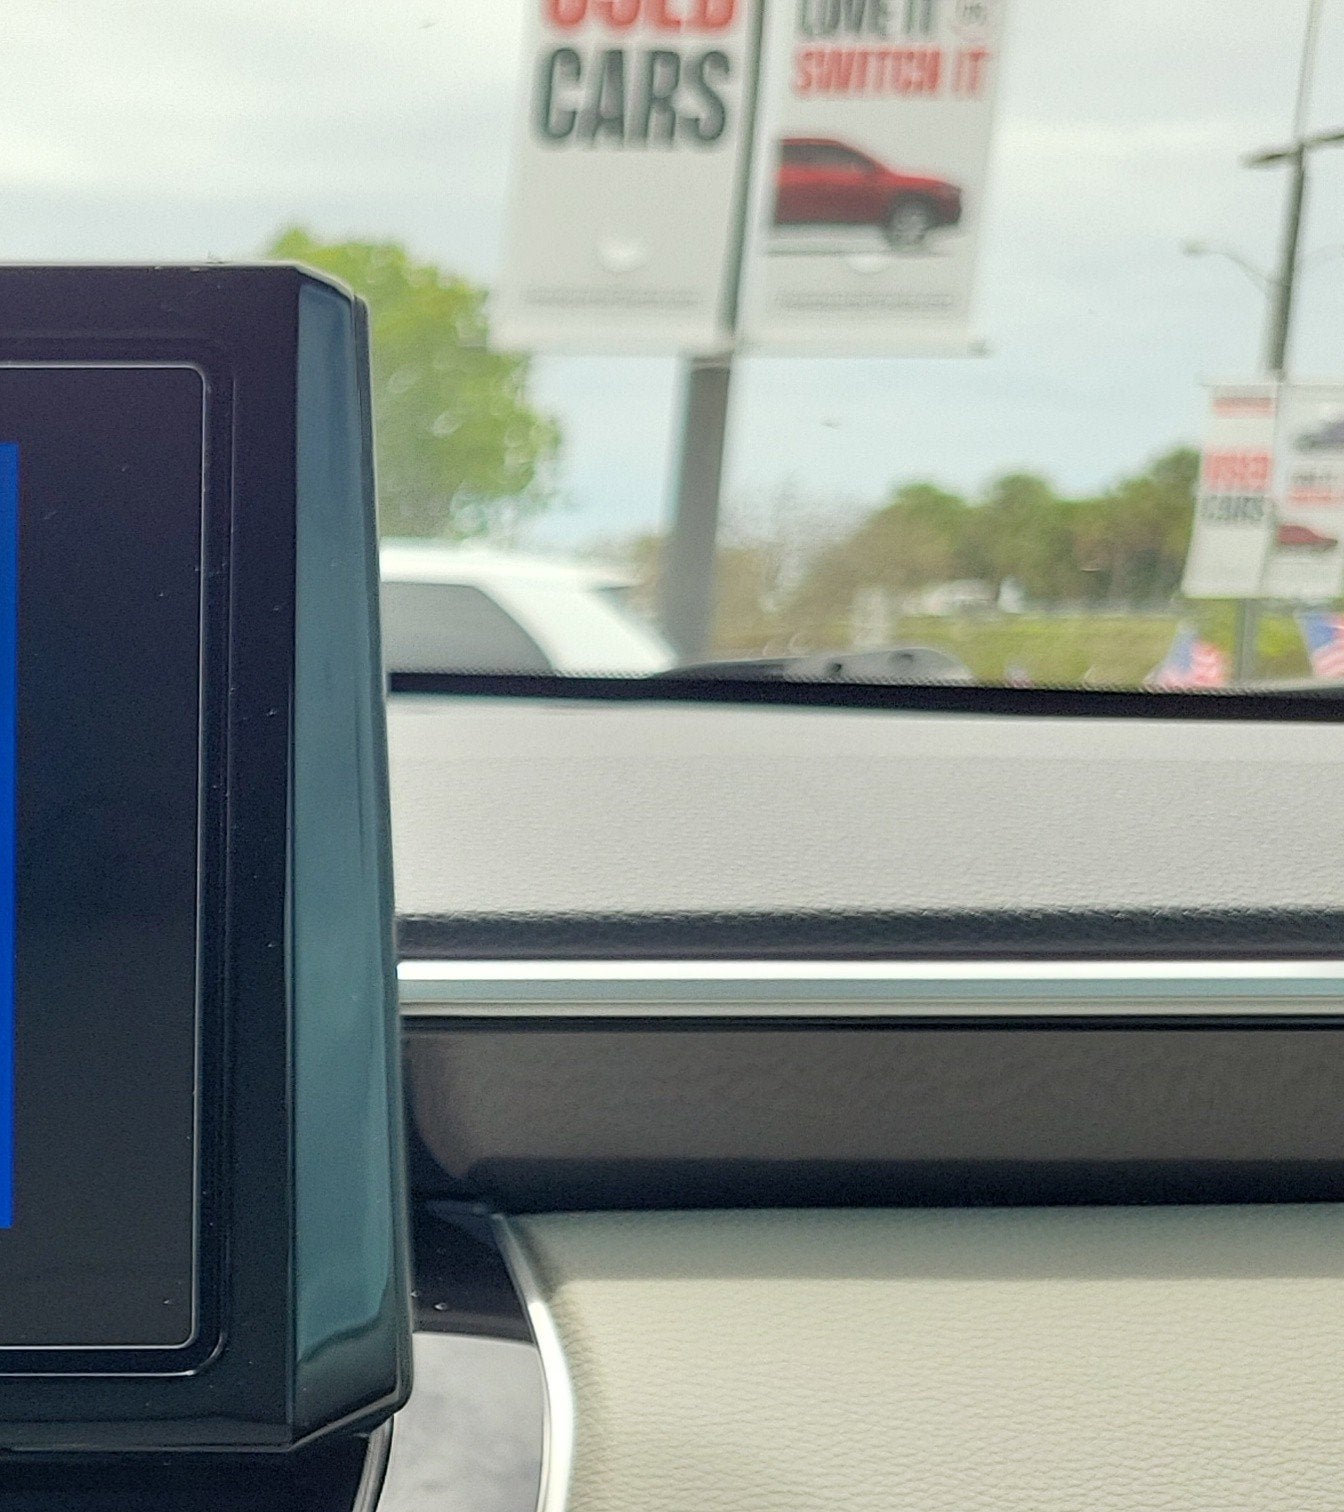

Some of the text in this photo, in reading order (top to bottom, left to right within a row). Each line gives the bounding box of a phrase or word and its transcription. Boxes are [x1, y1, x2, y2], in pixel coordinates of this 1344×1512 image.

[535, 47, 732, 149] CARS
[794, 44, 990, 97] SWITCH IT
